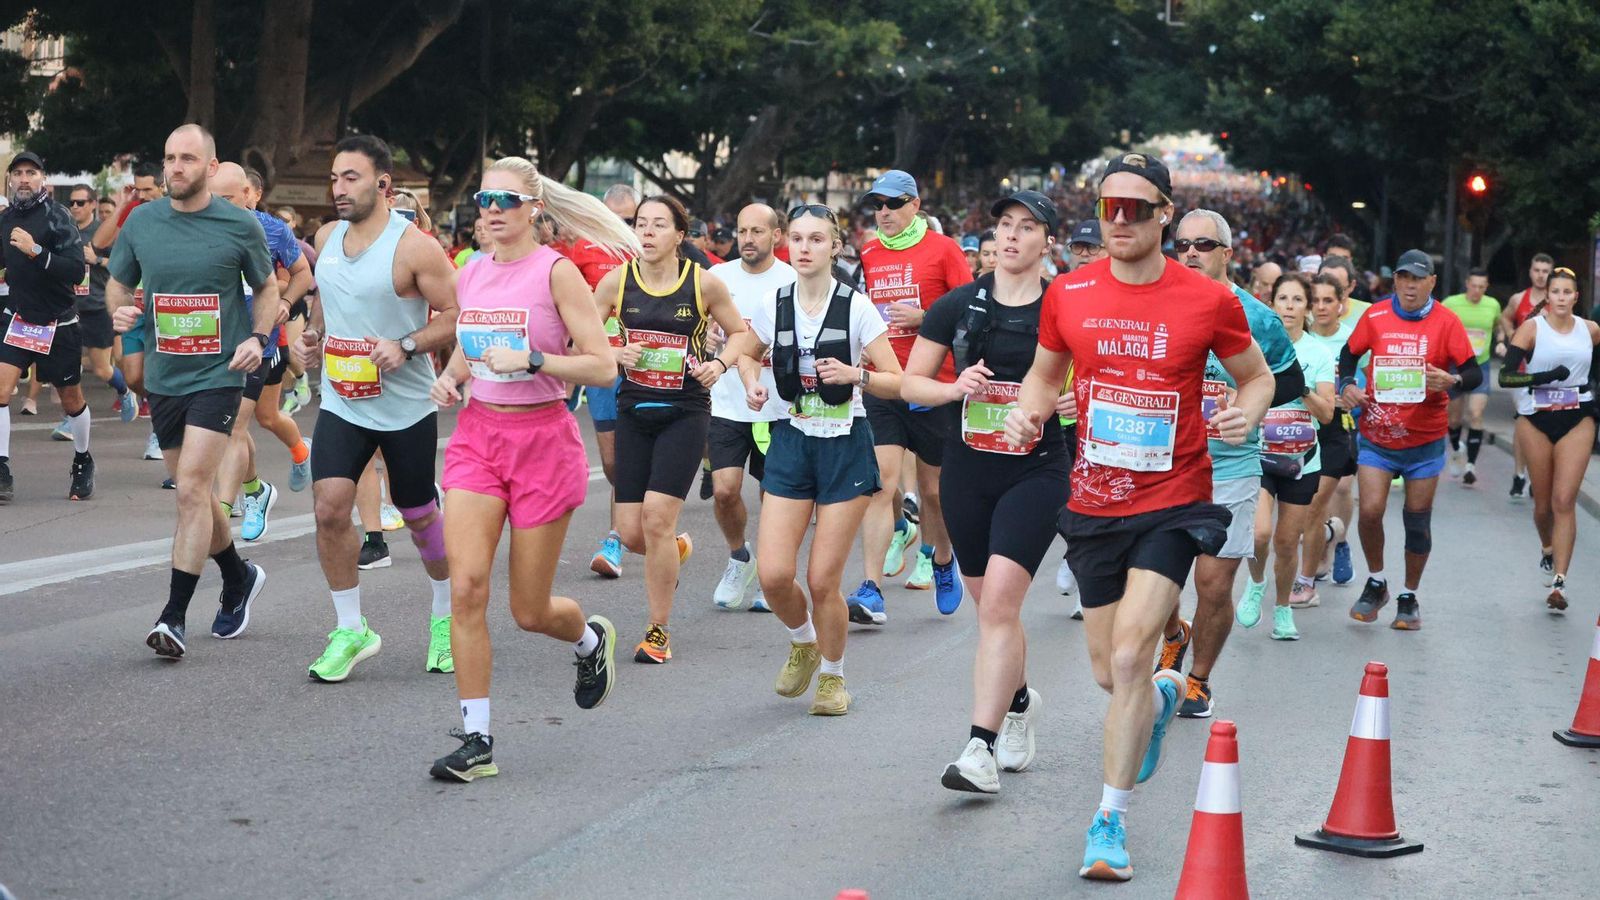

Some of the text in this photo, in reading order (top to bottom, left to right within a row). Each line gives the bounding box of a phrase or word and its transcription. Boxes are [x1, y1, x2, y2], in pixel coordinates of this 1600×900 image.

[1065, 281, 1088, 290] luanvi
[882, 288, 914, 298] GENERALI
[170, 297, 214, 307] GENERALI
[171, 316, 202, 328] 1352
[474, 312, 521, 324] GENERALI
[22, 325, 43, 335] 3344
[1098, 319, 1150, 332] GENERALI
[643, 333, 683, 345] GENERALI
[1097, 338, 1149, 359] MÁLAGA
[642, 350, 669, 364] 7225
[336, 359, 362, 373] 1566
[1385, 373, 1414, 383] 13941
[1114, 391, 1171, 409] GENERALI
[1547, 391, 1565, 399] 773
[1106, 415, 1157, 436] 12387
[1276, 426, 1302, 436] 6276
